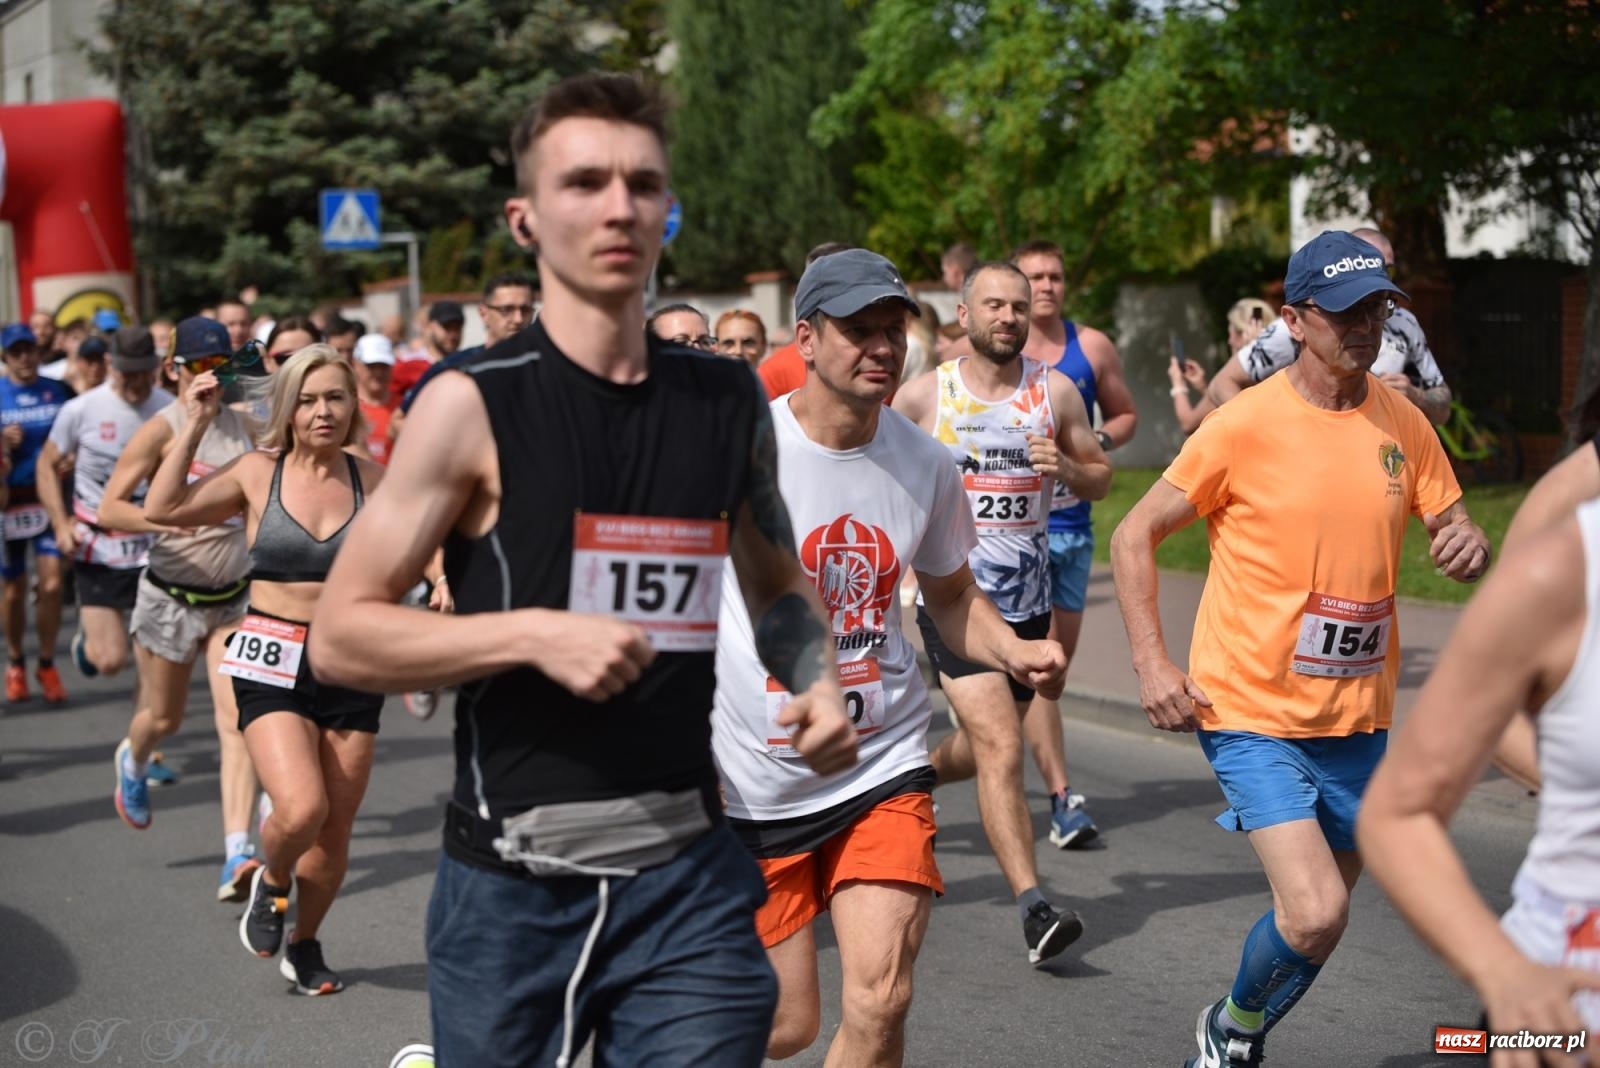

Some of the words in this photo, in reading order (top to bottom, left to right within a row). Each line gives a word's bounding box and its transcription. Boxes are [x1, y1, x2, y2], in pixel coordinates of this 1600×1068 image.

[1323, 255, 1382, 278] adidas
[1001, 448, 1024, 459] BIEG
[977, 495, 1028, 519] 233
[610, 561, 699, 614] 157
[1320, 597, 1337, 607] XVI
[1337, 600, 1358, 611] BIEG
[237, 635, 282, 667] 198
[1321, 622, 1381, 657] 154
[840, 662, 869, 675] GRANIC
